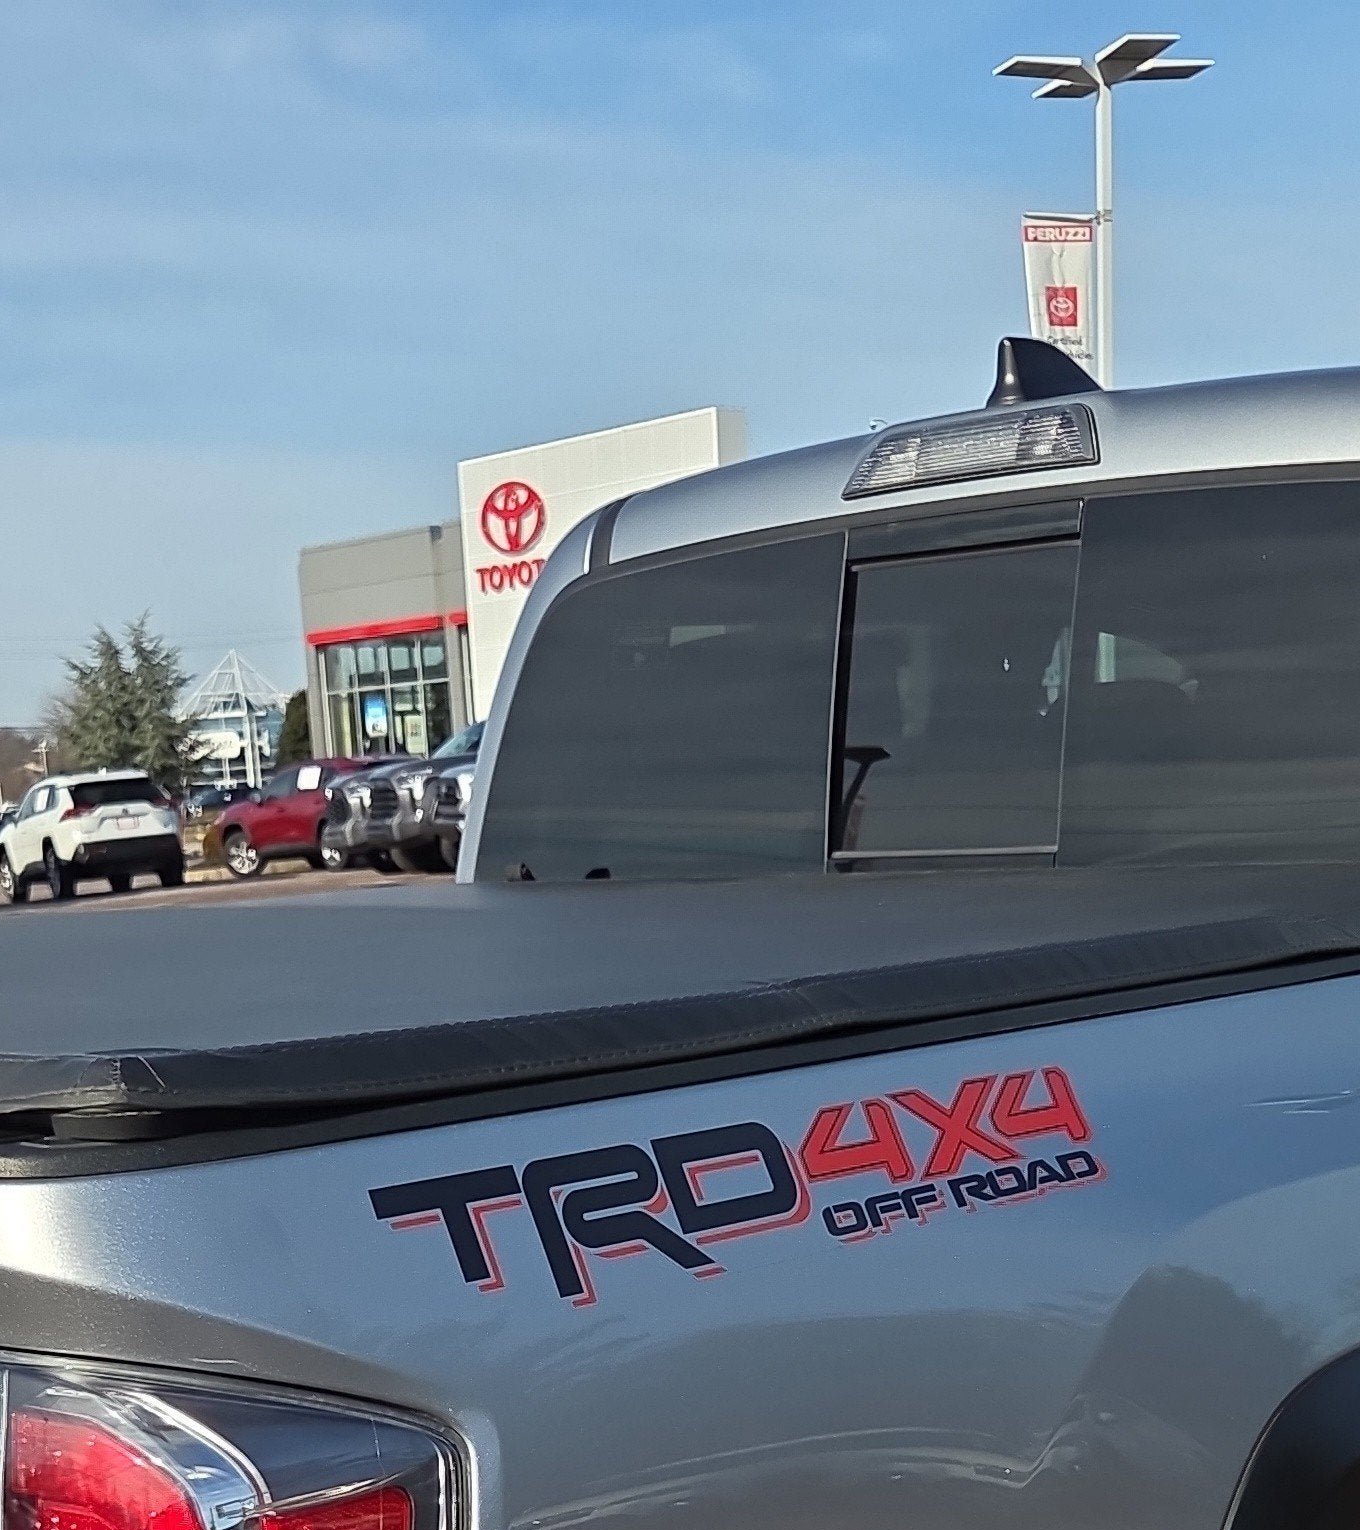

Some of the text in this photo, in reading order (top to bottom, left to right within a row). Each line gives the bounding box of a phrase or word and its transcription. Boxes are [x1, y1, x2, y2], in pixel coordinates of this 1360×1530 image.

[1027, 226, 1088, 241] PERUZZI
[476, 559, 547, 595] TOYOT
[368, 1121, 810, 1307] TRD
[821, 1149, 1105, 1243] OFF ROAD
